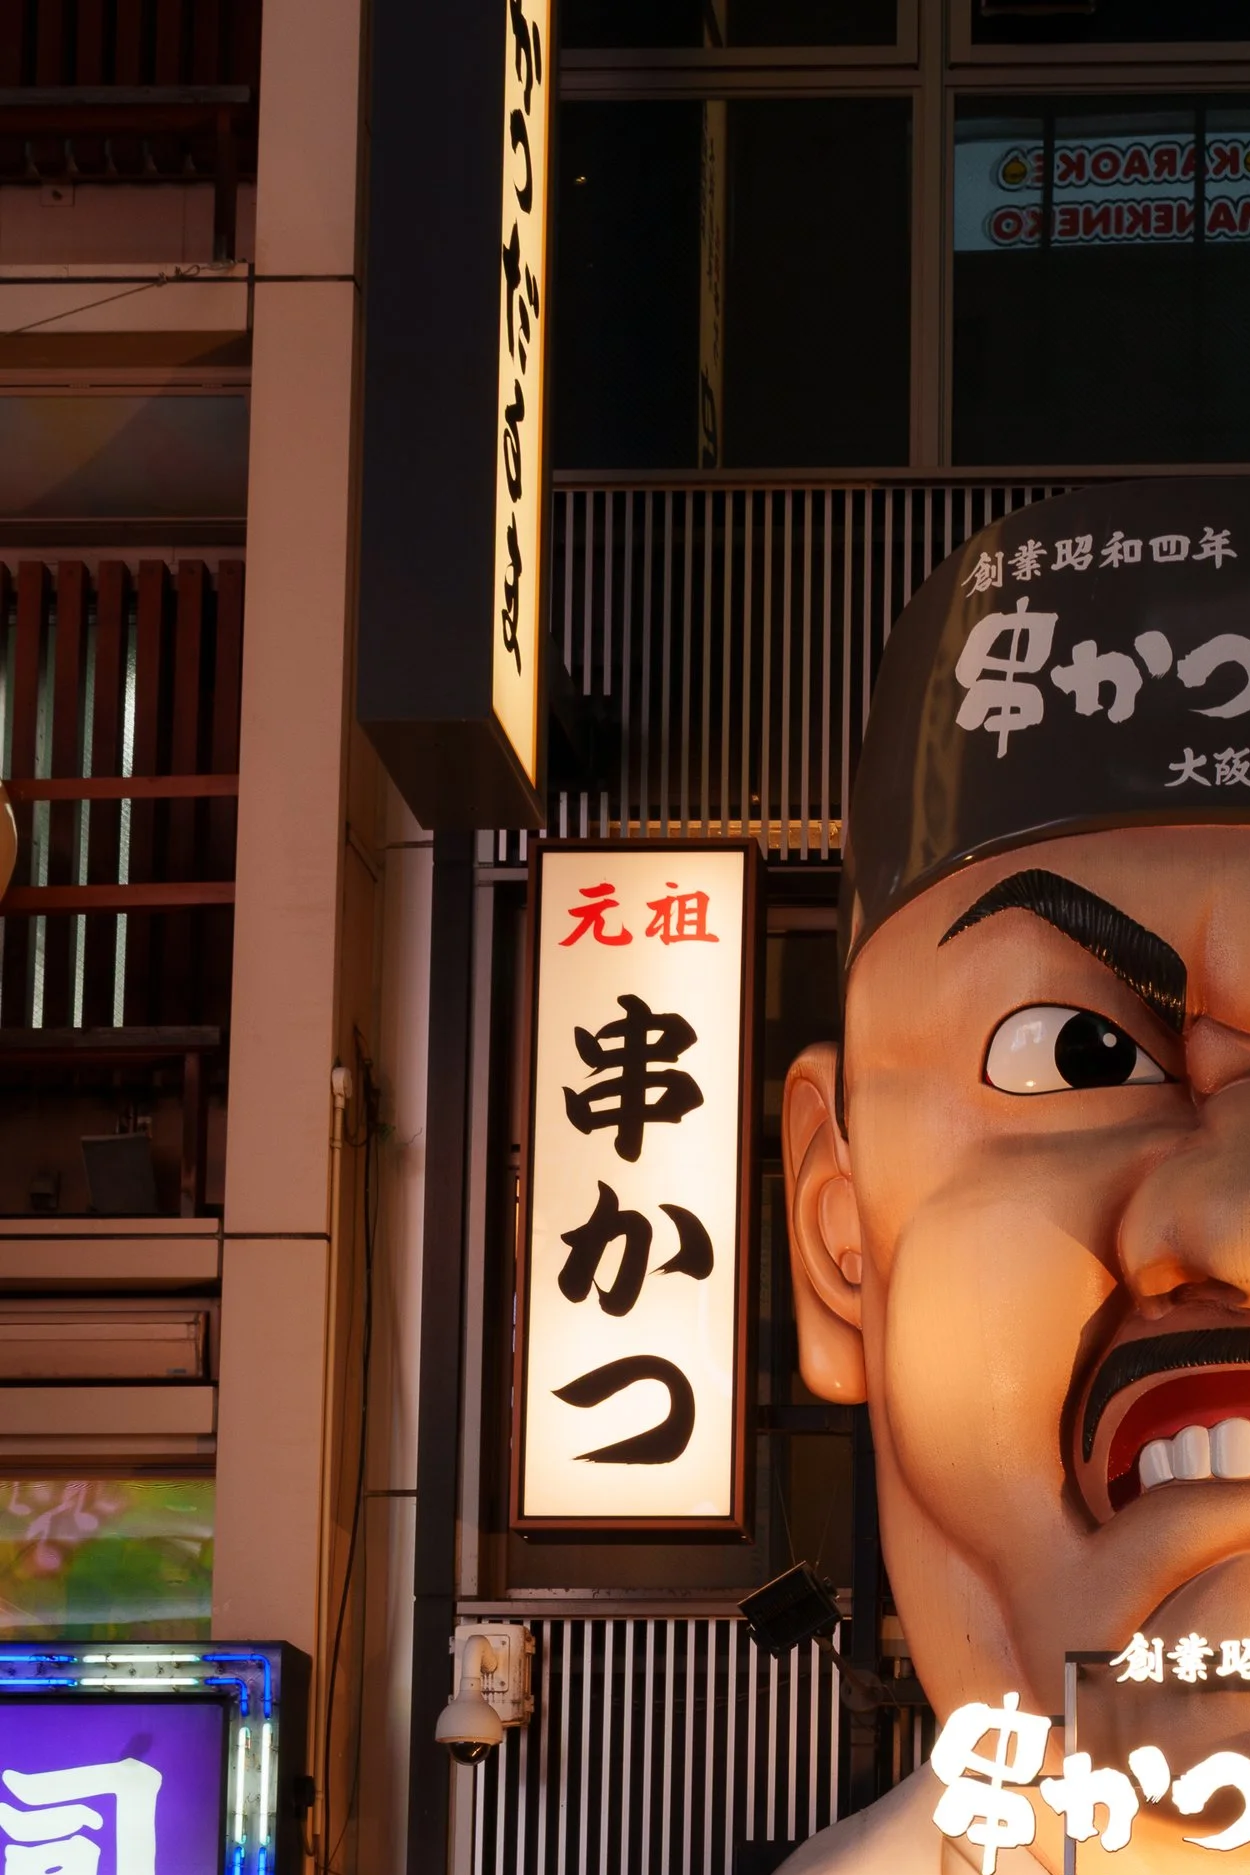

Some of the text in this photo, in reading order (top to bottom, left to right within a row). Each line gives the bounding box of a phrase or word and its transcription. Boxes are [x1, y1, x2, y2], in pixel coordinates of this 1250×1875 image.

[961, 526, 1238, 598] 創業昭和四年
[558, 882, 720, 947] 元祖
[551, 993, 715, 1464] 串かつ
